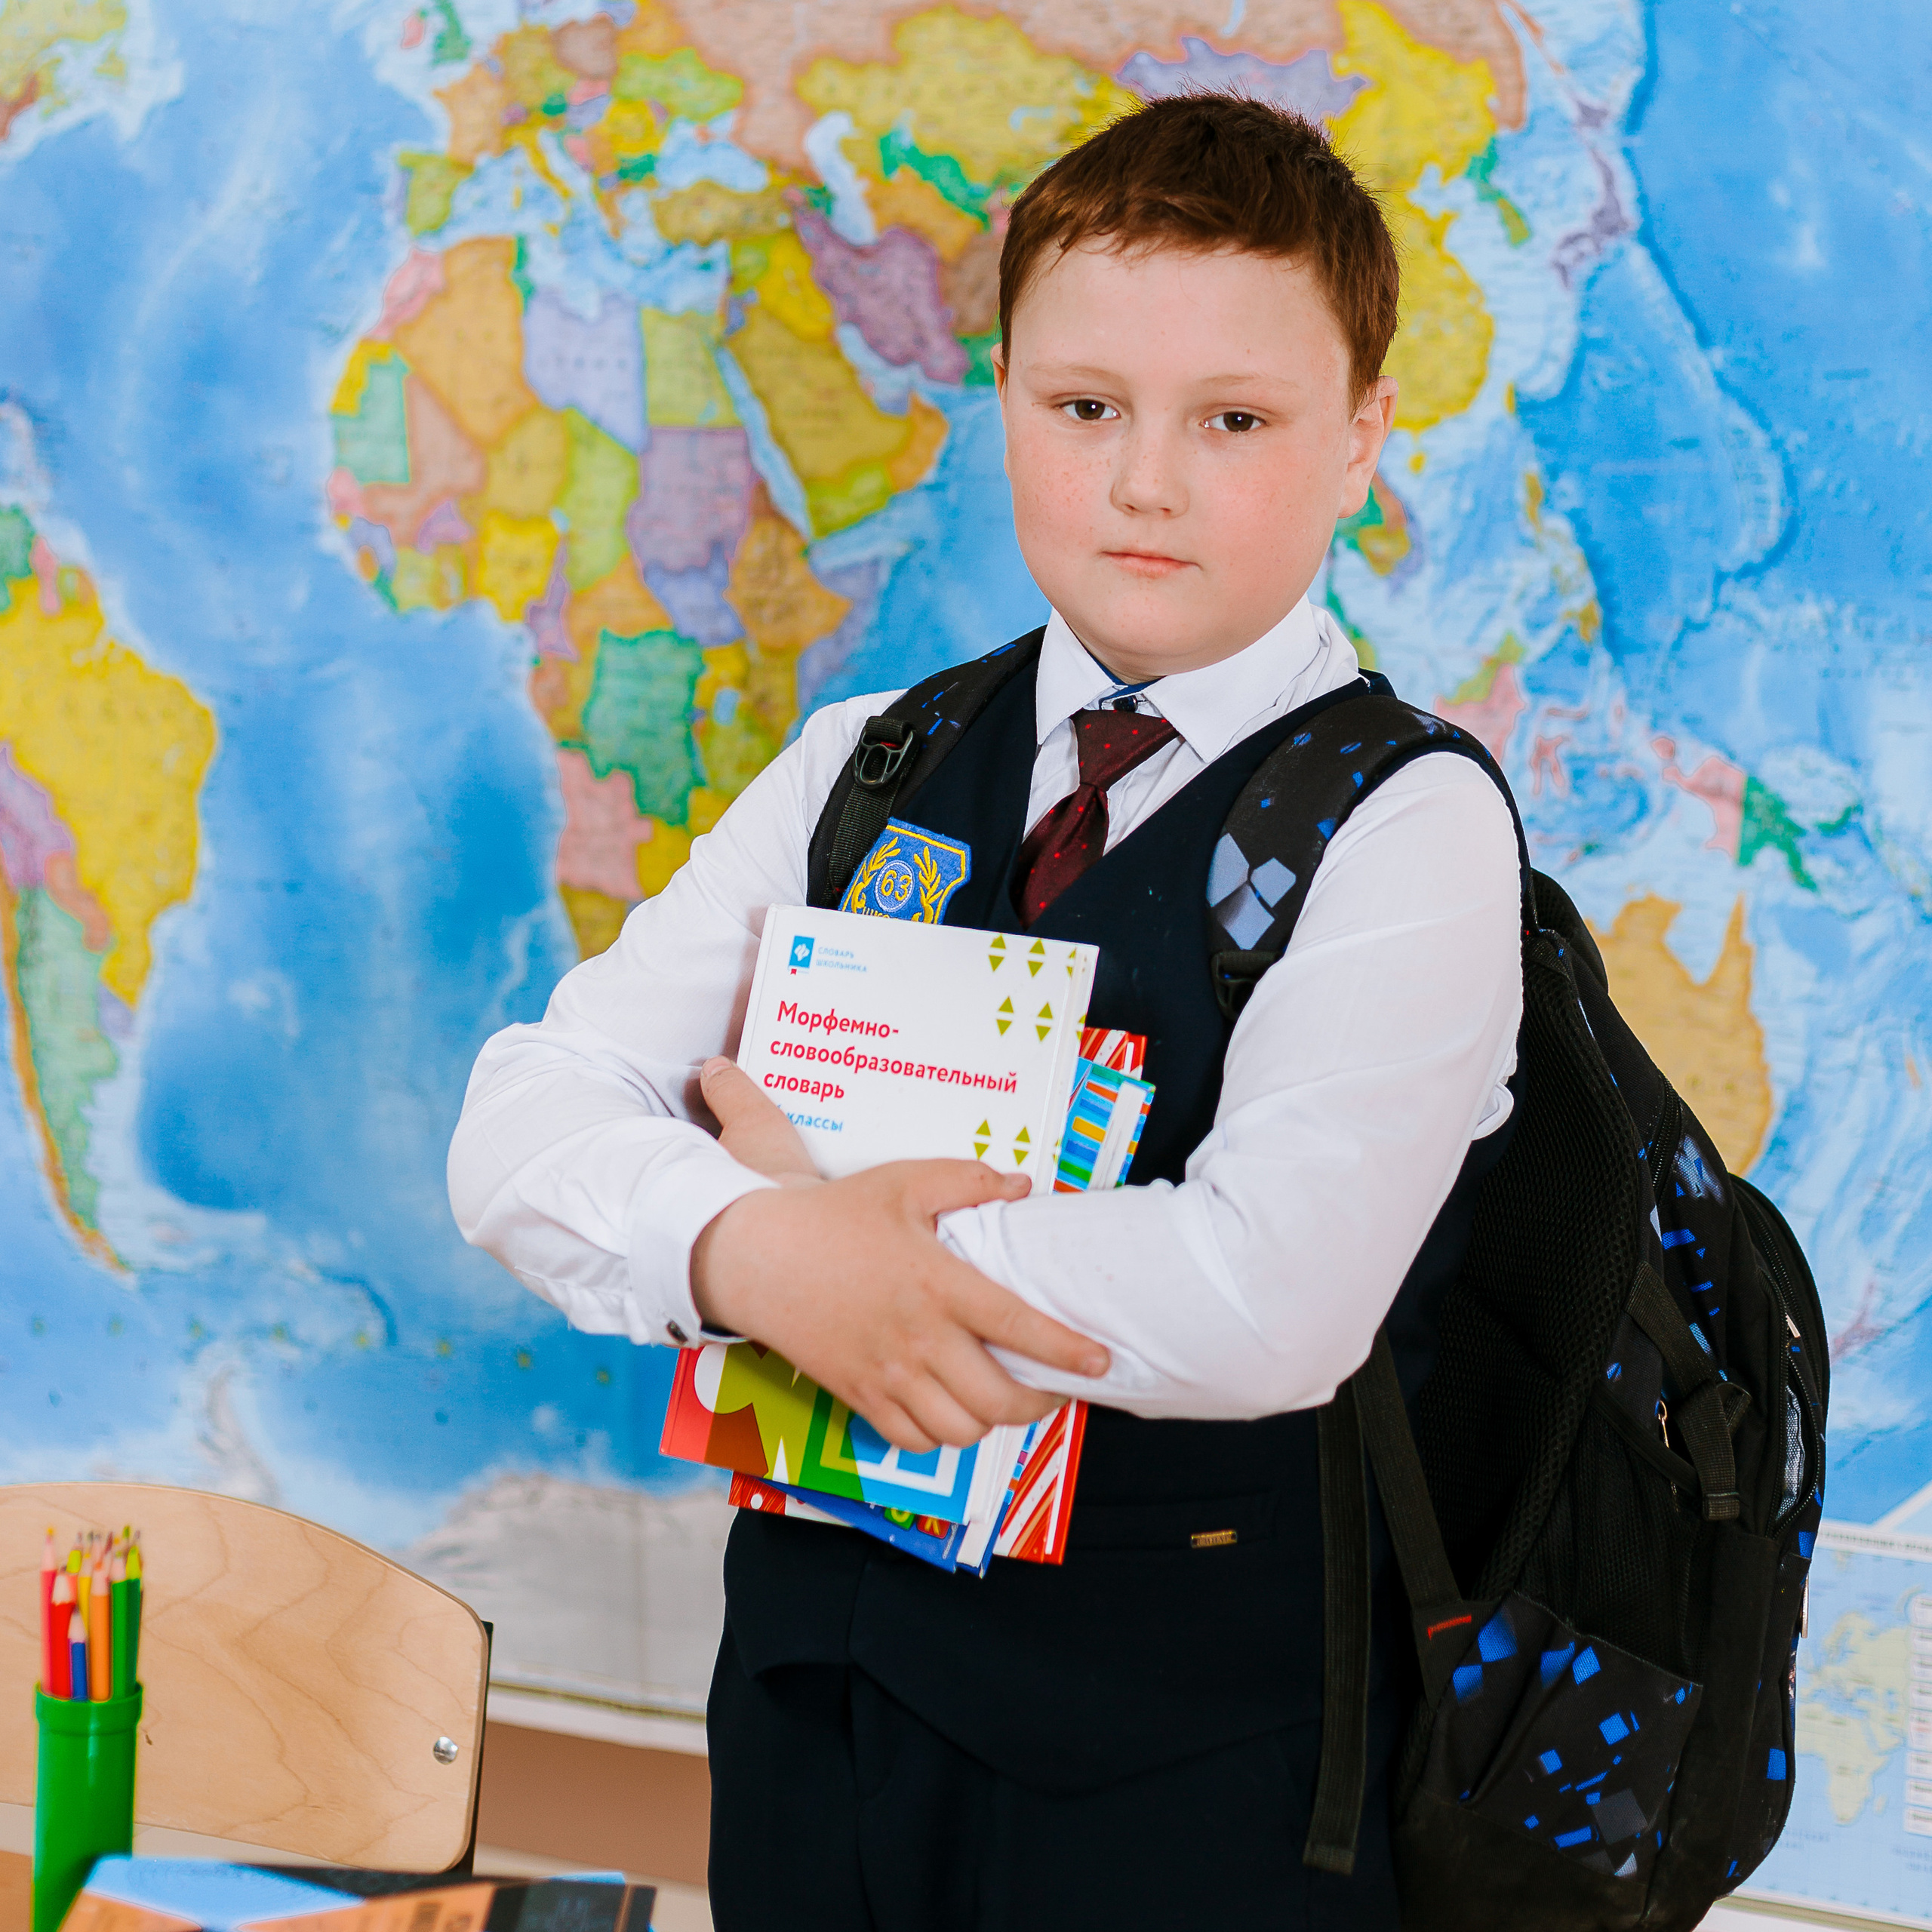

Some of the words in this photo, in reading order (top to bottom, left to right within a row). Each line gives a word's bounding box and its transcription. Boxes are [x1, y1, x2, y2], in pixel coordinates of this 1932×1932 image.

[880, 869, 911, 901] 63
[815, 958, 867, 972] ШКОЛЬНИКА
[817, 946, 854, 958] СЛОВАРЬ
[777, 1000, 900, 1039] Морфемно-
[770, 1040, 1017, 1094] словообразовательный
[763, 1072, 845, 1103] словарь
